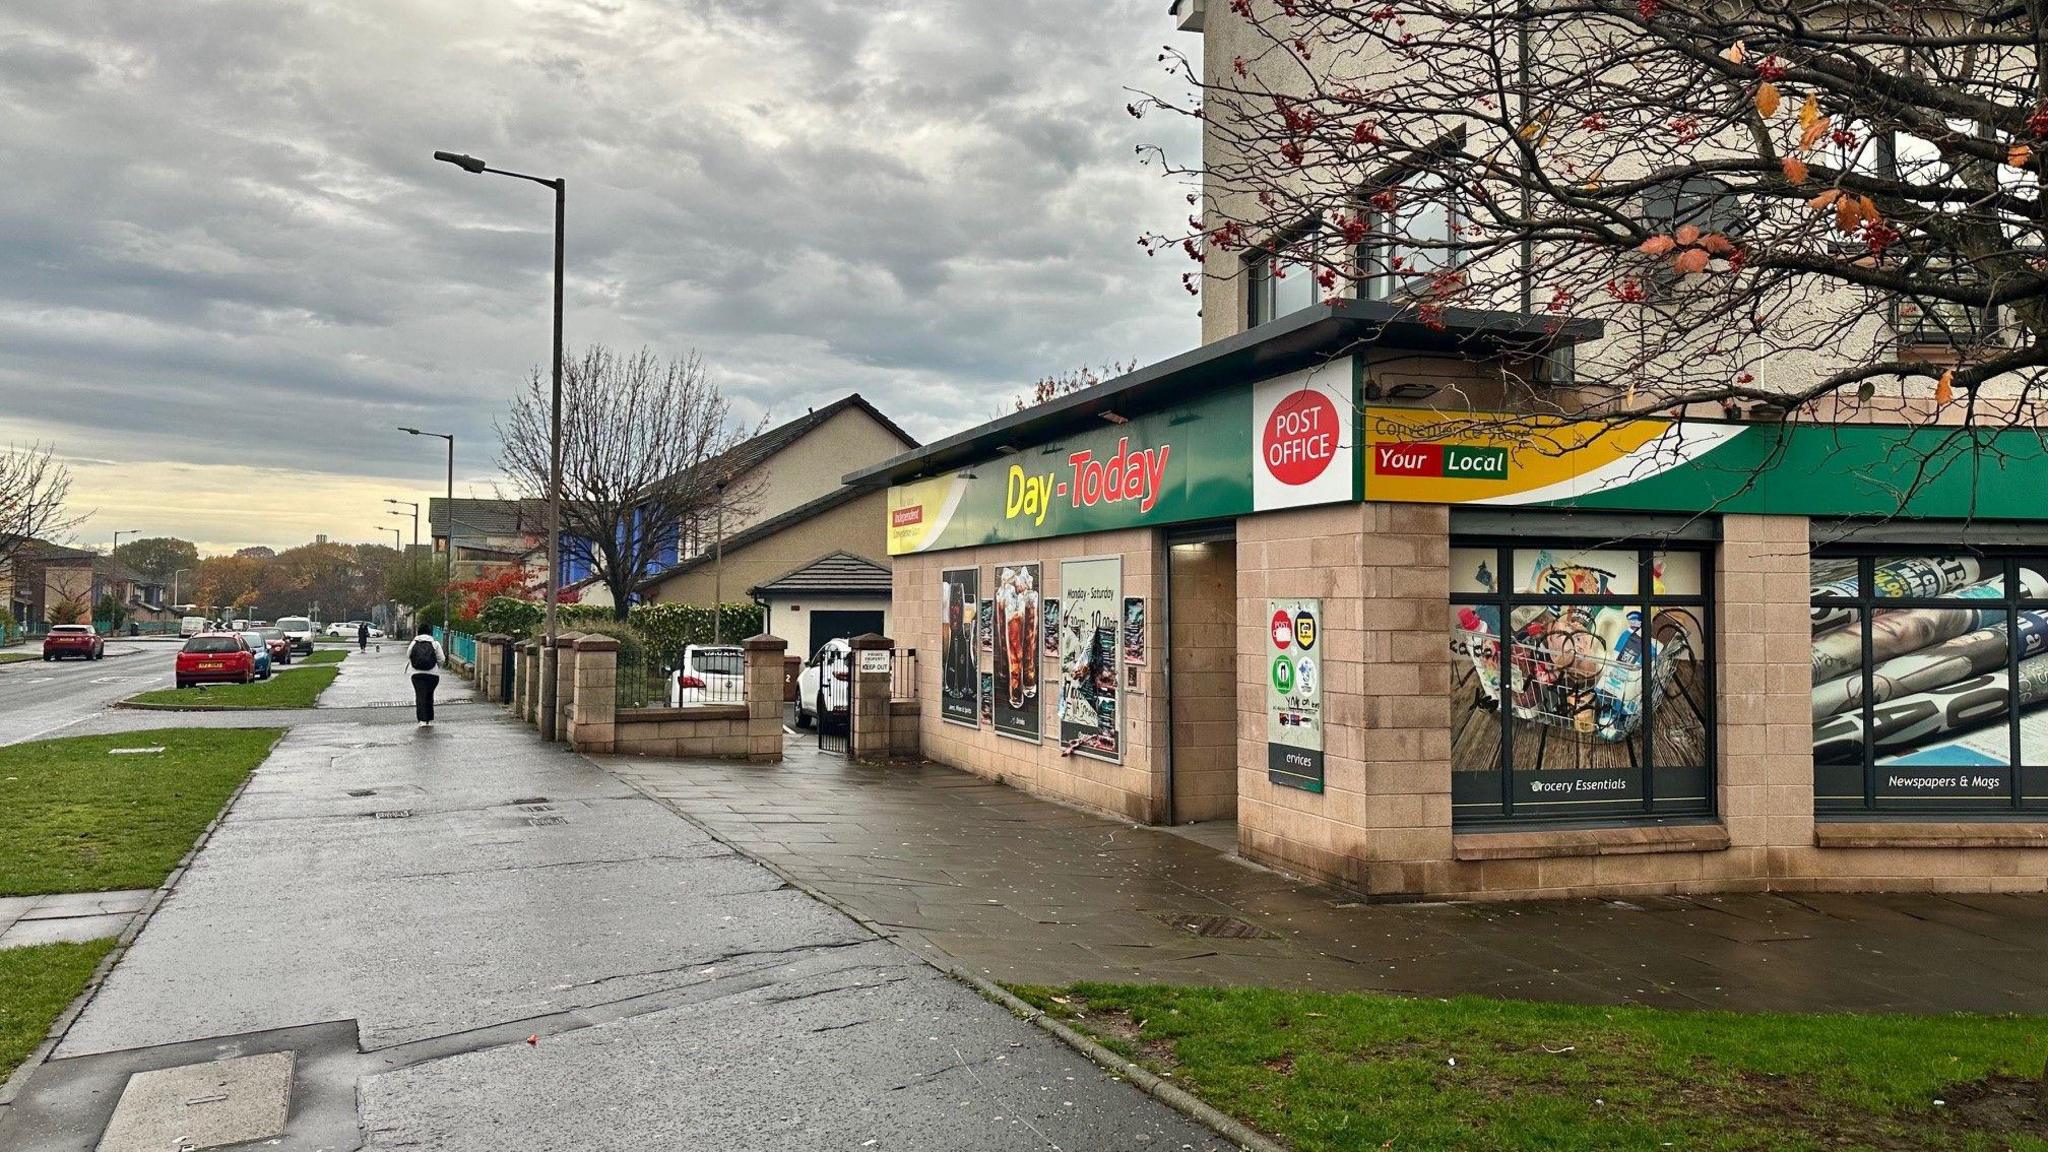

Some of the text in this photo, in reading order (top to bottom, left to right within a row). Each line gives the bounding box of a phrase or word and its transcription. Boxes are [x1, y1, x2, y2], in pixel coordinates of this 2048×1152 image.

[1276, 406, 1322, 438] POST
[1269, 433, 1330, 466] OFFICE
[1380, 448, 1503, 472] Your Local
[1006, 464, 1055, 527] Day
[1068, 437, 1170, 513] Today
[1090, 587, 1114, 601] Saturday
[786, 674, 791, 683] 2
[1576, 778, 1626, 790] Essentials
[1888, 775, 2000, 789] Newspapers & Mags
